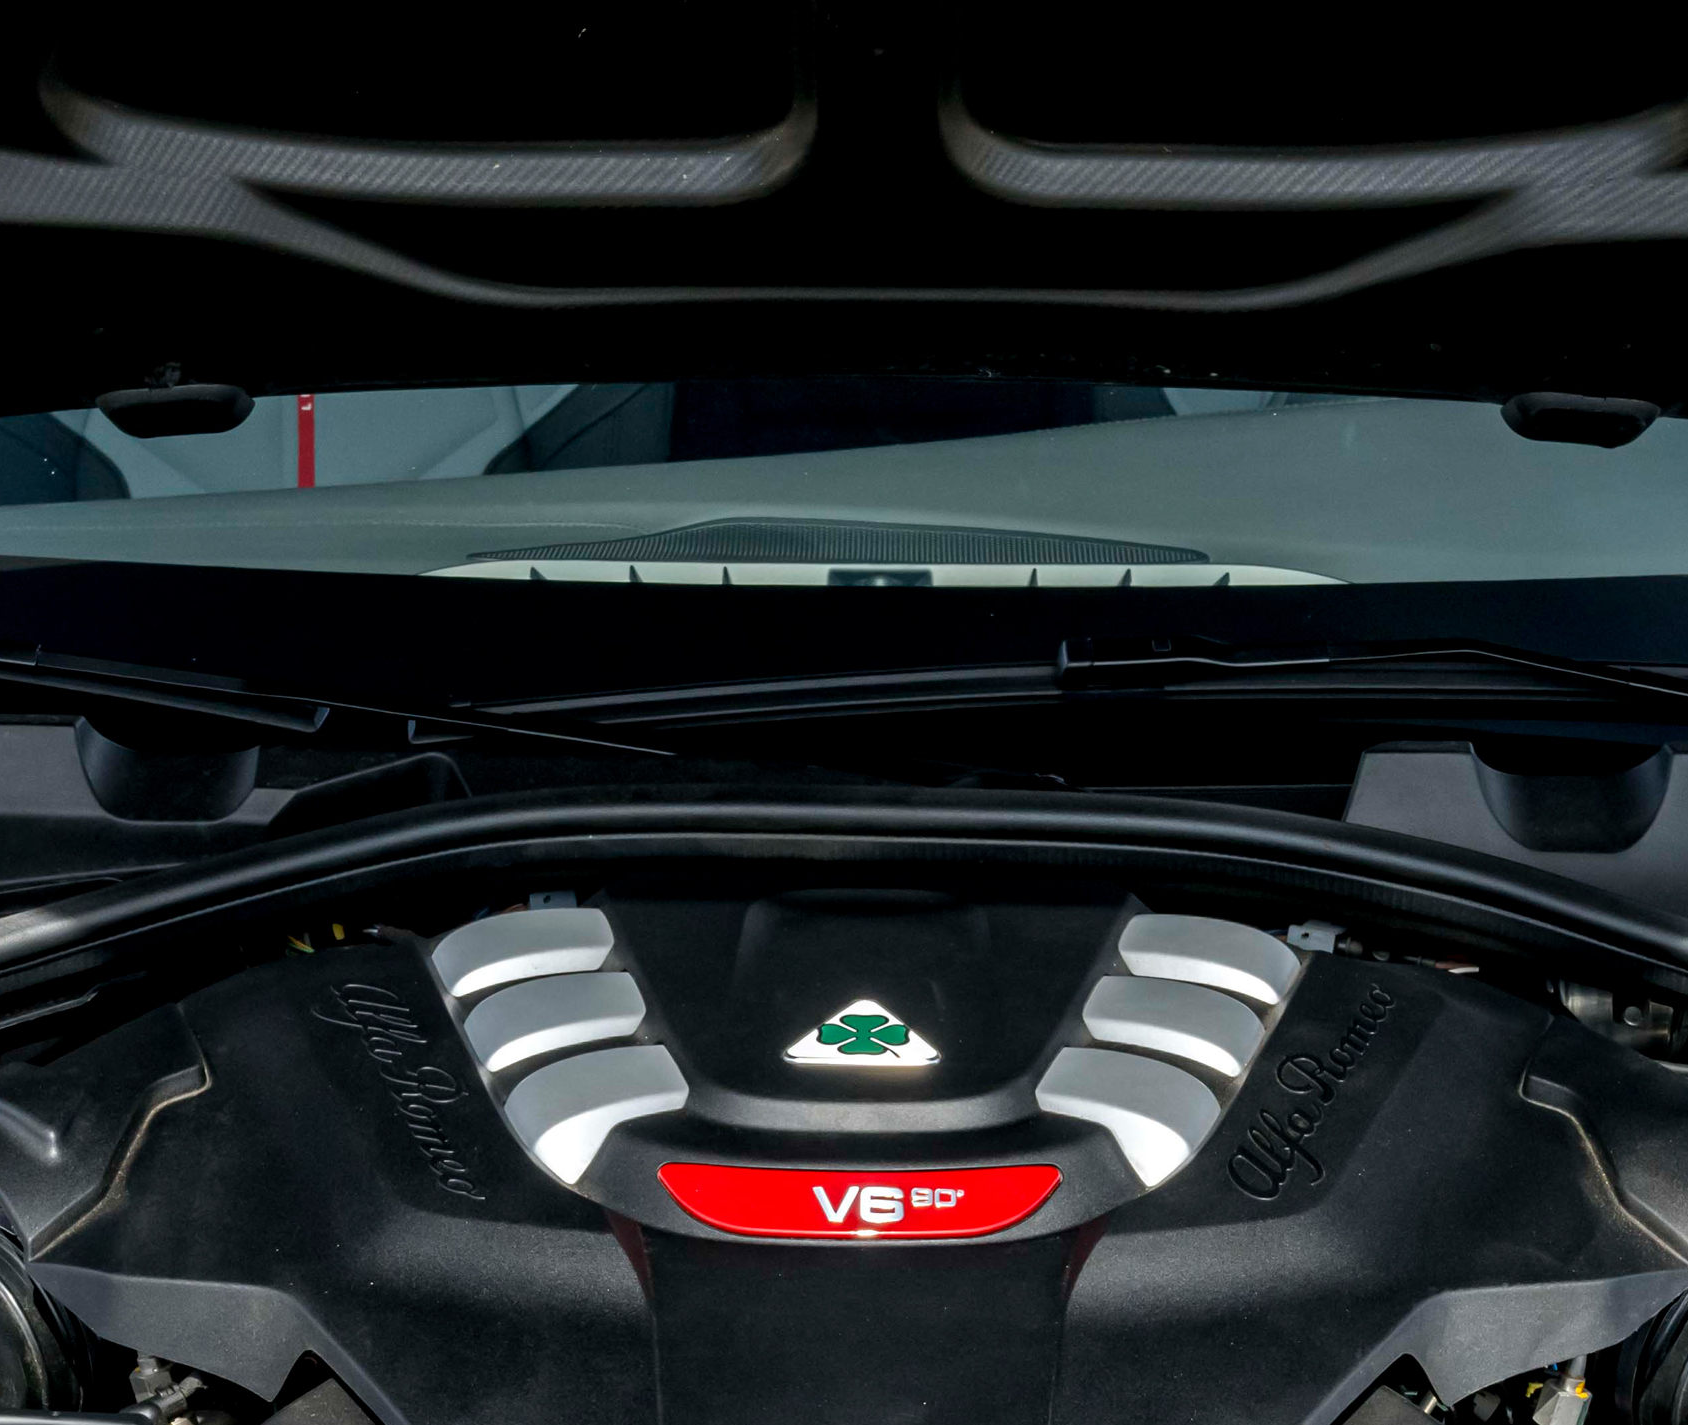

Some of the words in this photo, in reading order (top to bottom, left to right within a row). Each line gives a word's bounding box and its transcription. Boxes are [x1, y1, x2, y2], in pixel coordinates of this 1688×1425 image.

[311, 984, 427, 1065] Alfa
[379, 1066, 486, 1200] Romeo
[1276, 983, 1395, 1106] Romeo
[812, 1185, 904, 1226] V6
[1227, 1101, 1326, 1200] Alfa
